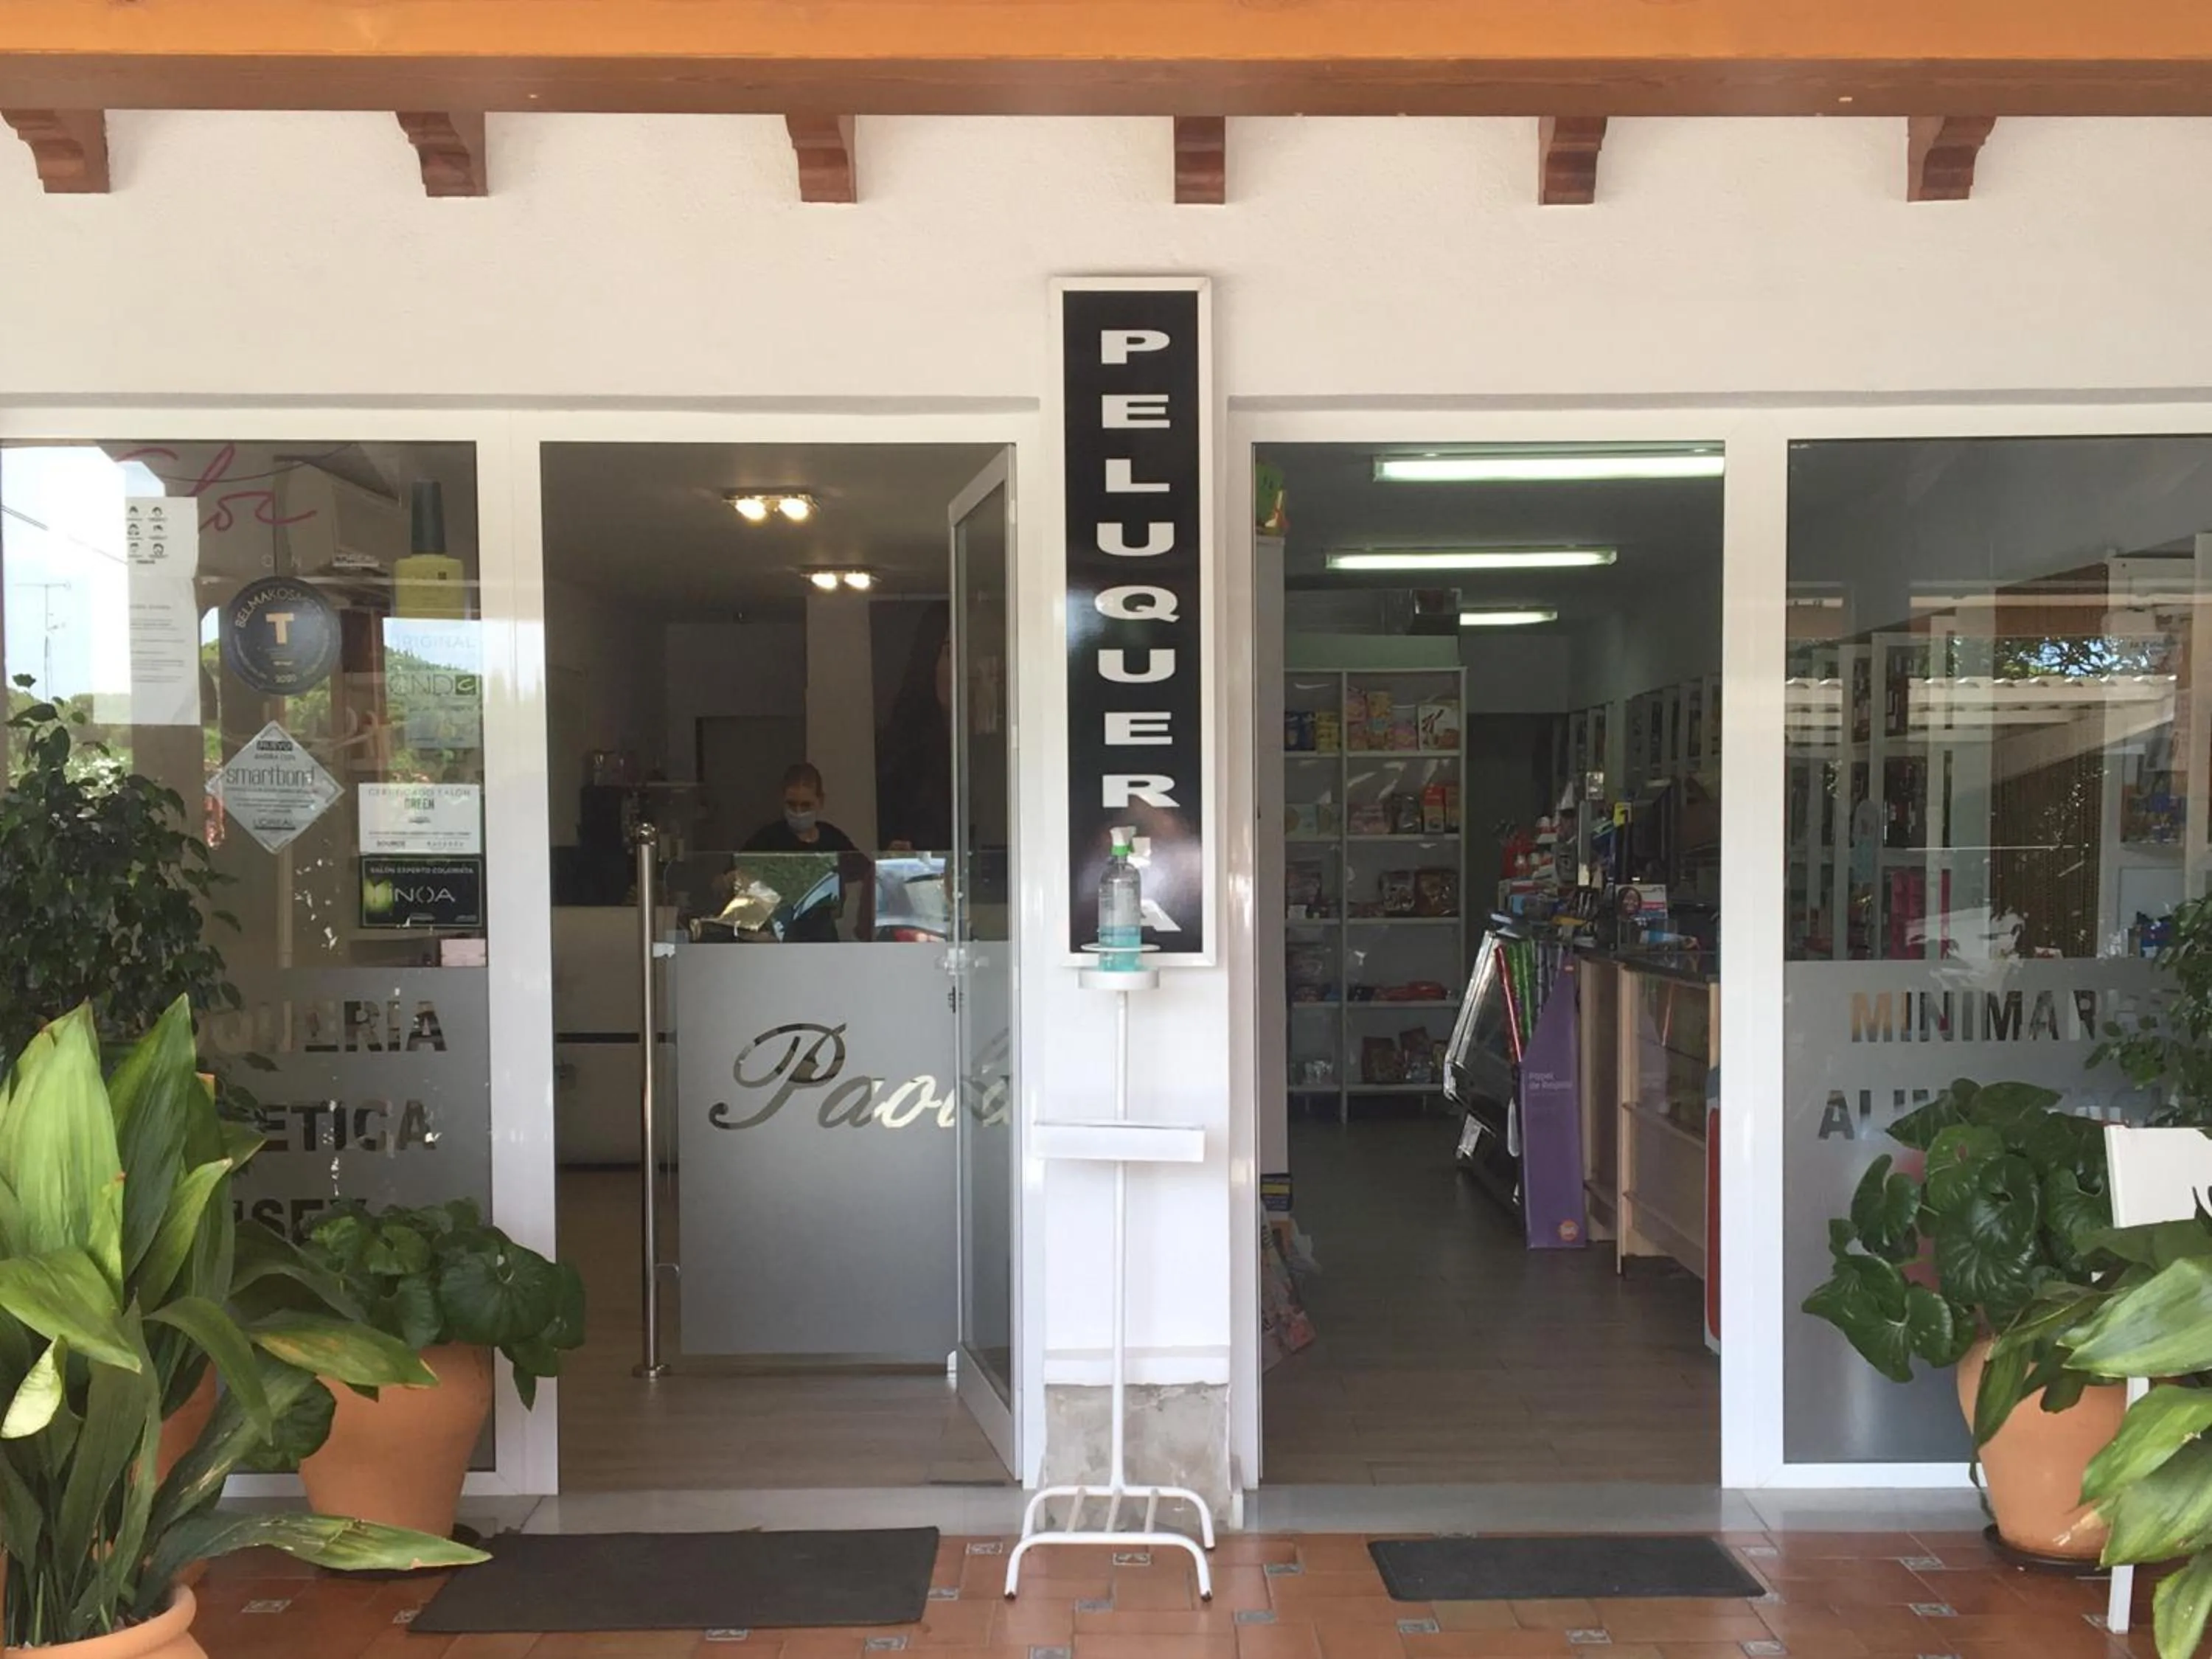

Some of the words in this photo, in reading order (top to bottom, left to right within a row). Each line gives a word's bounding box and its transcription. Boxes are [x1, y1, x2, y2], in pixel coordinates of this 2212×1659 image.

[265, 613, 294, 644] T
[389, 635, 476, 649] RIGINAL
[226, 765, 315, 785] smartbond
[1850, 990, 2179, 1042] MINIMAR
[254, 1099, 437, 1152] ETICA
